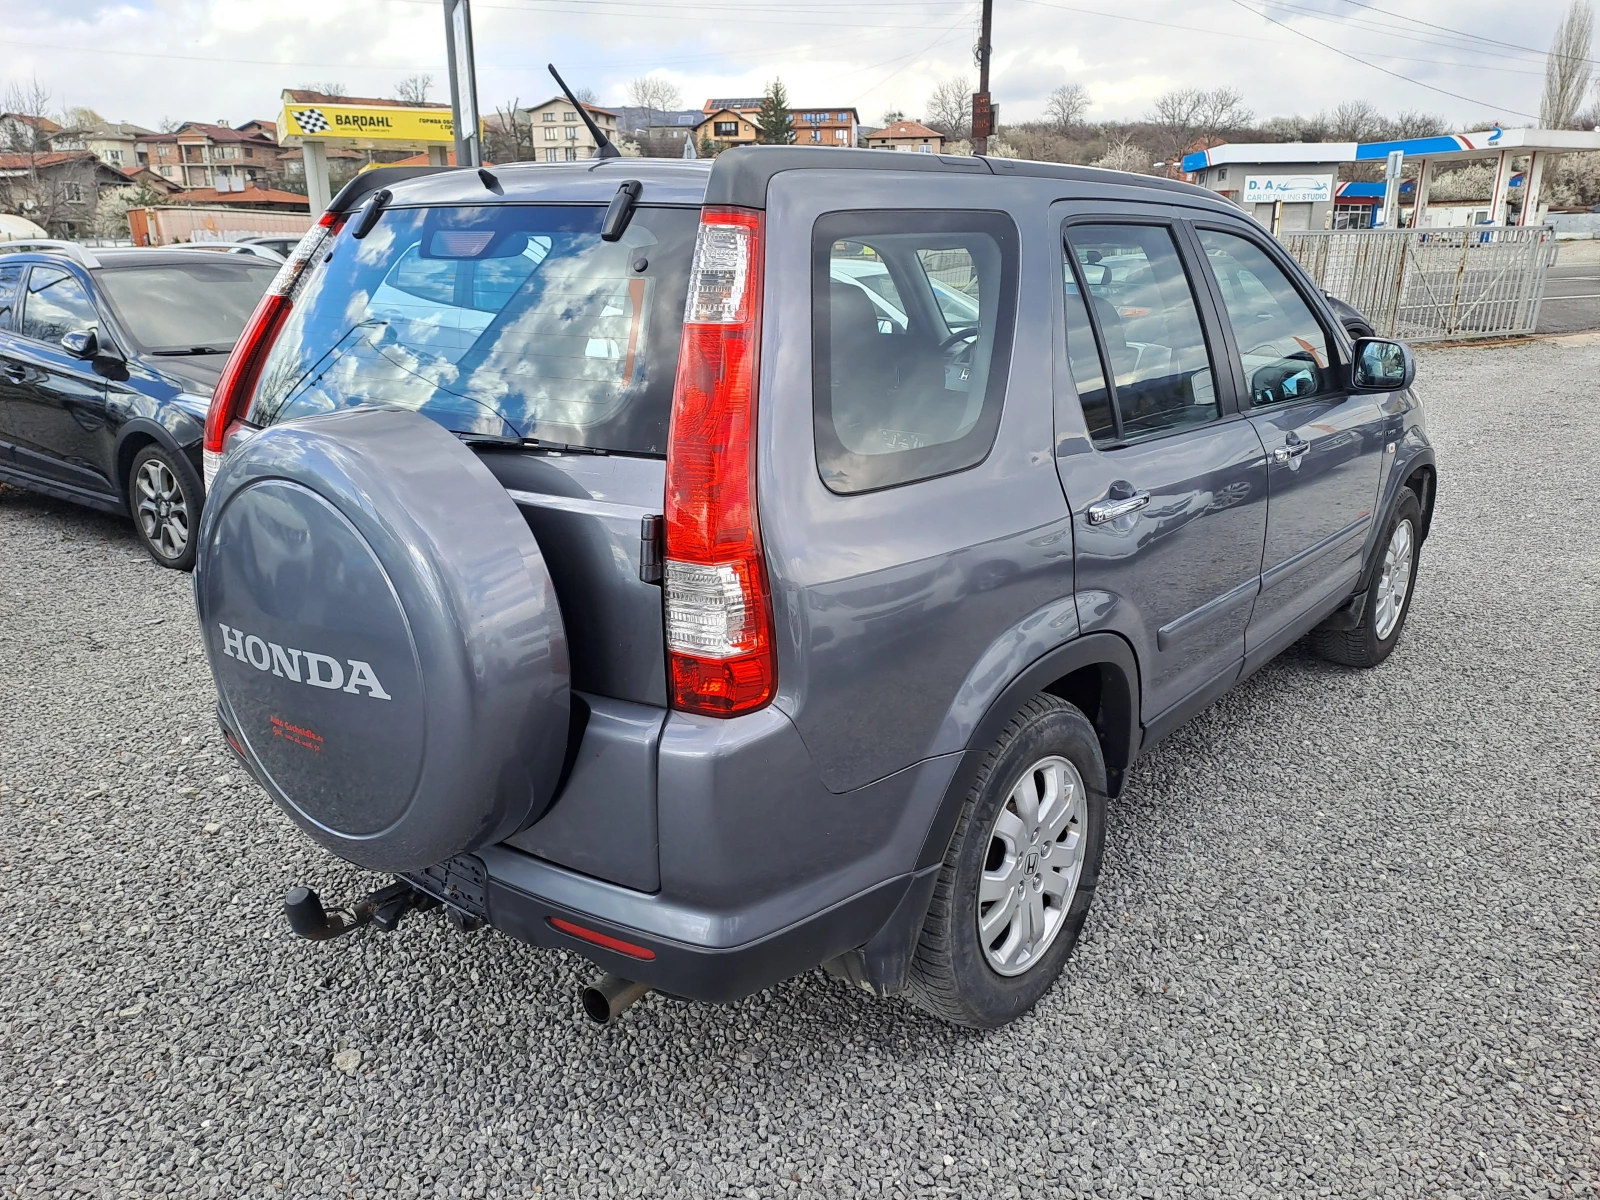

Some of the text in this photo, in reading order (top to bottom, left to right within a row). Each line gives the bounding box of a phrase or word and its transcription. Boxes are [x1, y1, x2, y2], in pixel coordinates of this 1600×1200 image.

[335, 115, 392, 131] BARDAHL
[1265, 180, 1274, 190] A
[218, 622, 392, 701] HONDA
